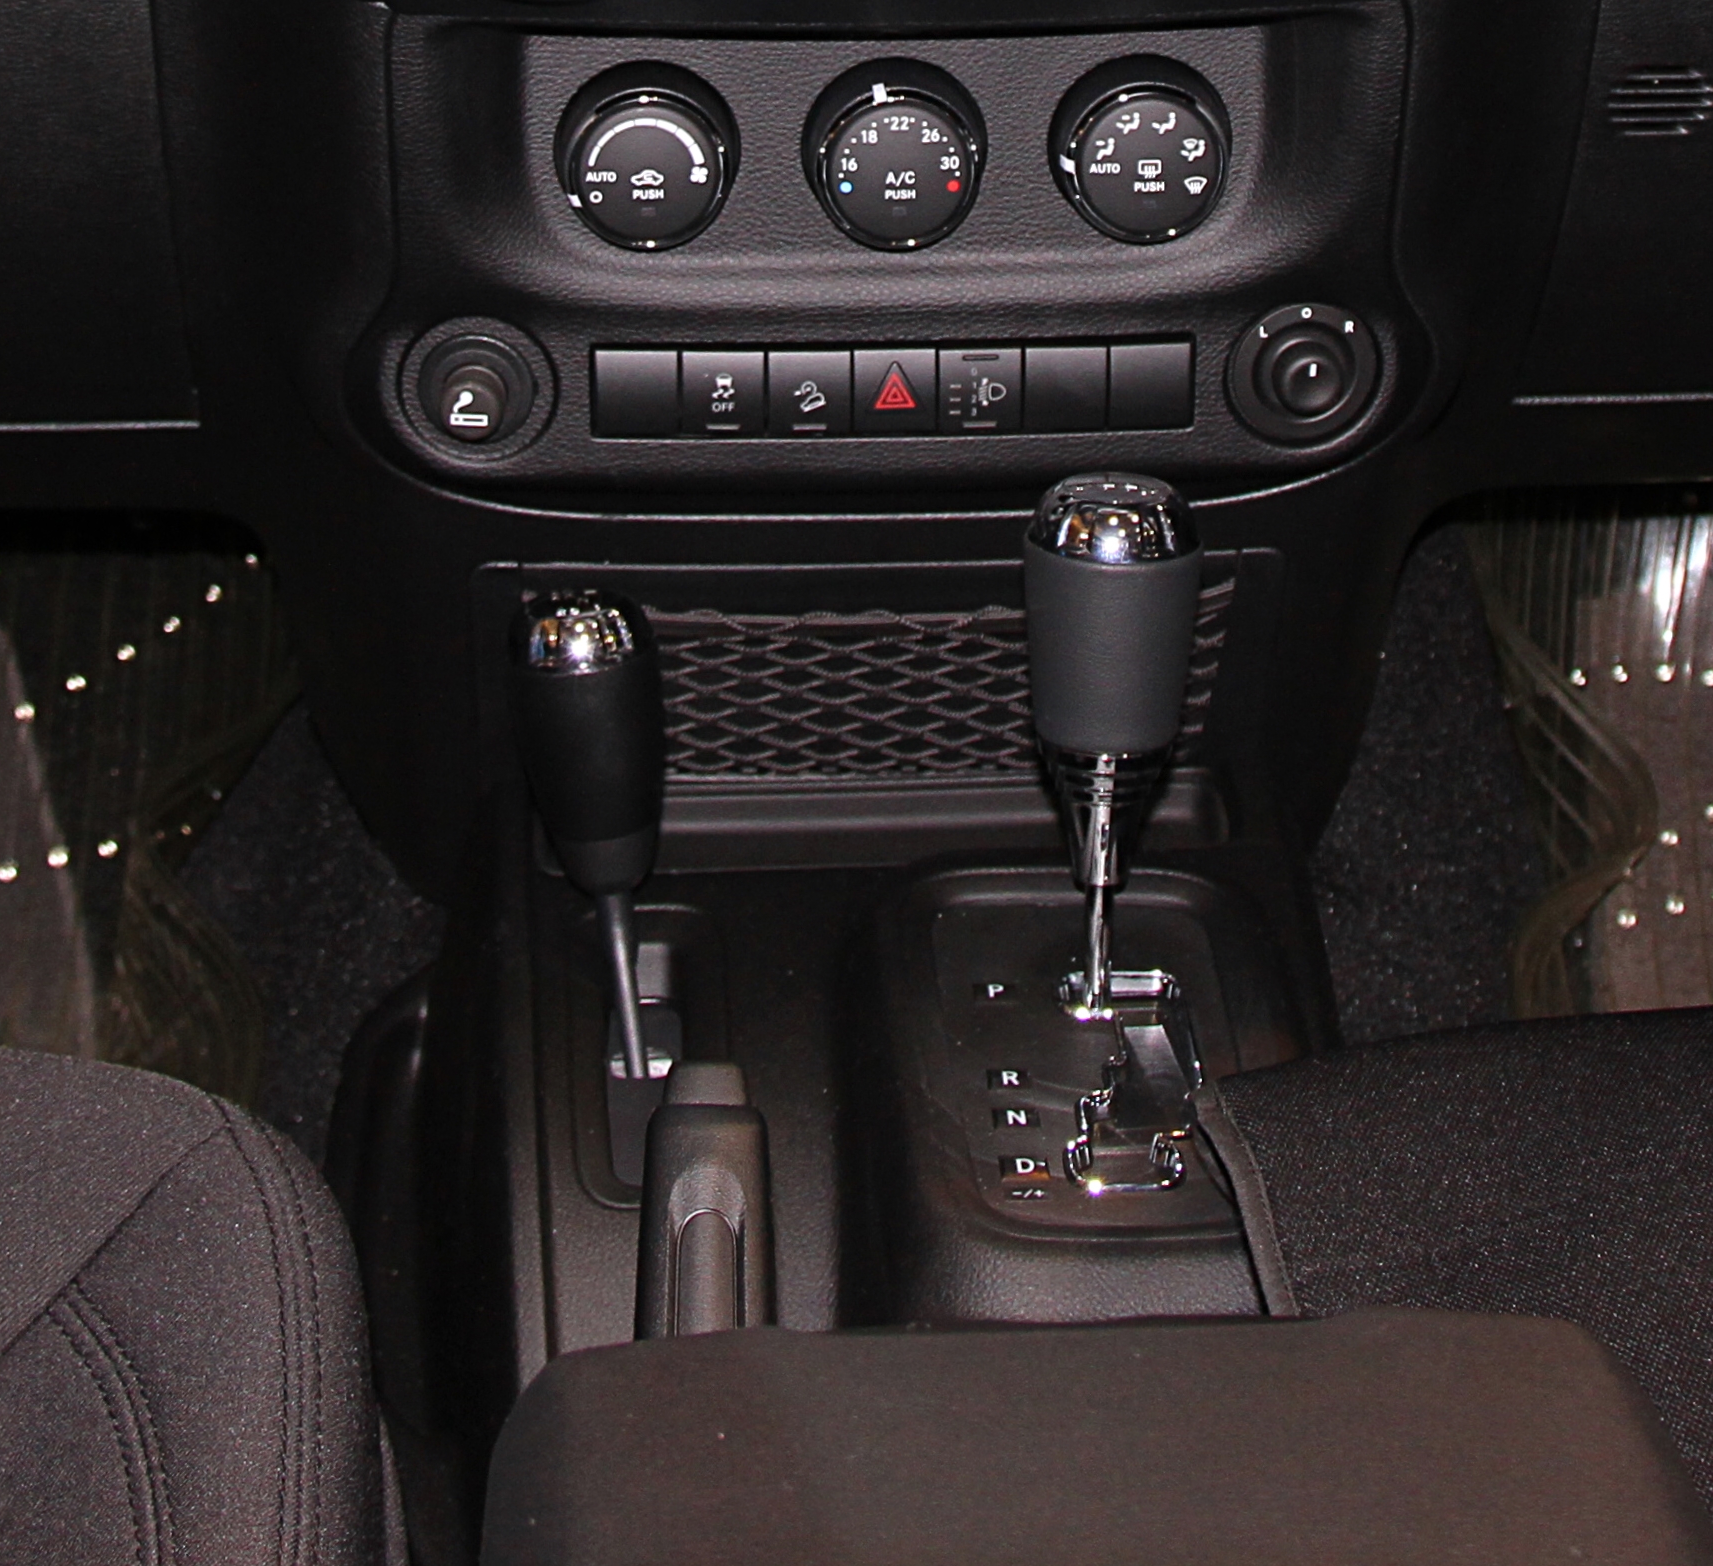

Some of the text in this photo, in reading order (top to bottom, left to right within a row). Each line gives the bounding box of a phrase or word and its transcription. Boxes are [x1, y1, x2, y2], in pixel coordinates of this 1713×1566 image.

[890, 116, 909, 131] 22
[861, 129, 879, 144] 18
[921, 128, 940, 143] 26
[841, 158, 858, 171] 16
[940, 156, 960, 170] 30
[1090, 163, 1121, 174] AUTO
[586, 171, 617, 182] AUTO
[885, 171, 916, 187] A/C
[1134, 181, 1165, 192] PUSH
[632, 189, 664, 200] PUSH
[884, 189, 916, 200] PUSH
[1259, 325, 1269, 338] L
[1345, 320, 1355, 333] R
[712, 402, 735, 413] OFF
[988, 984, 1004, 998] P
[1002, 1070, 1020, 1085] R
[1006, 1109, 1027, 1125] N
[1015, 1158, 1035, 1174] D
